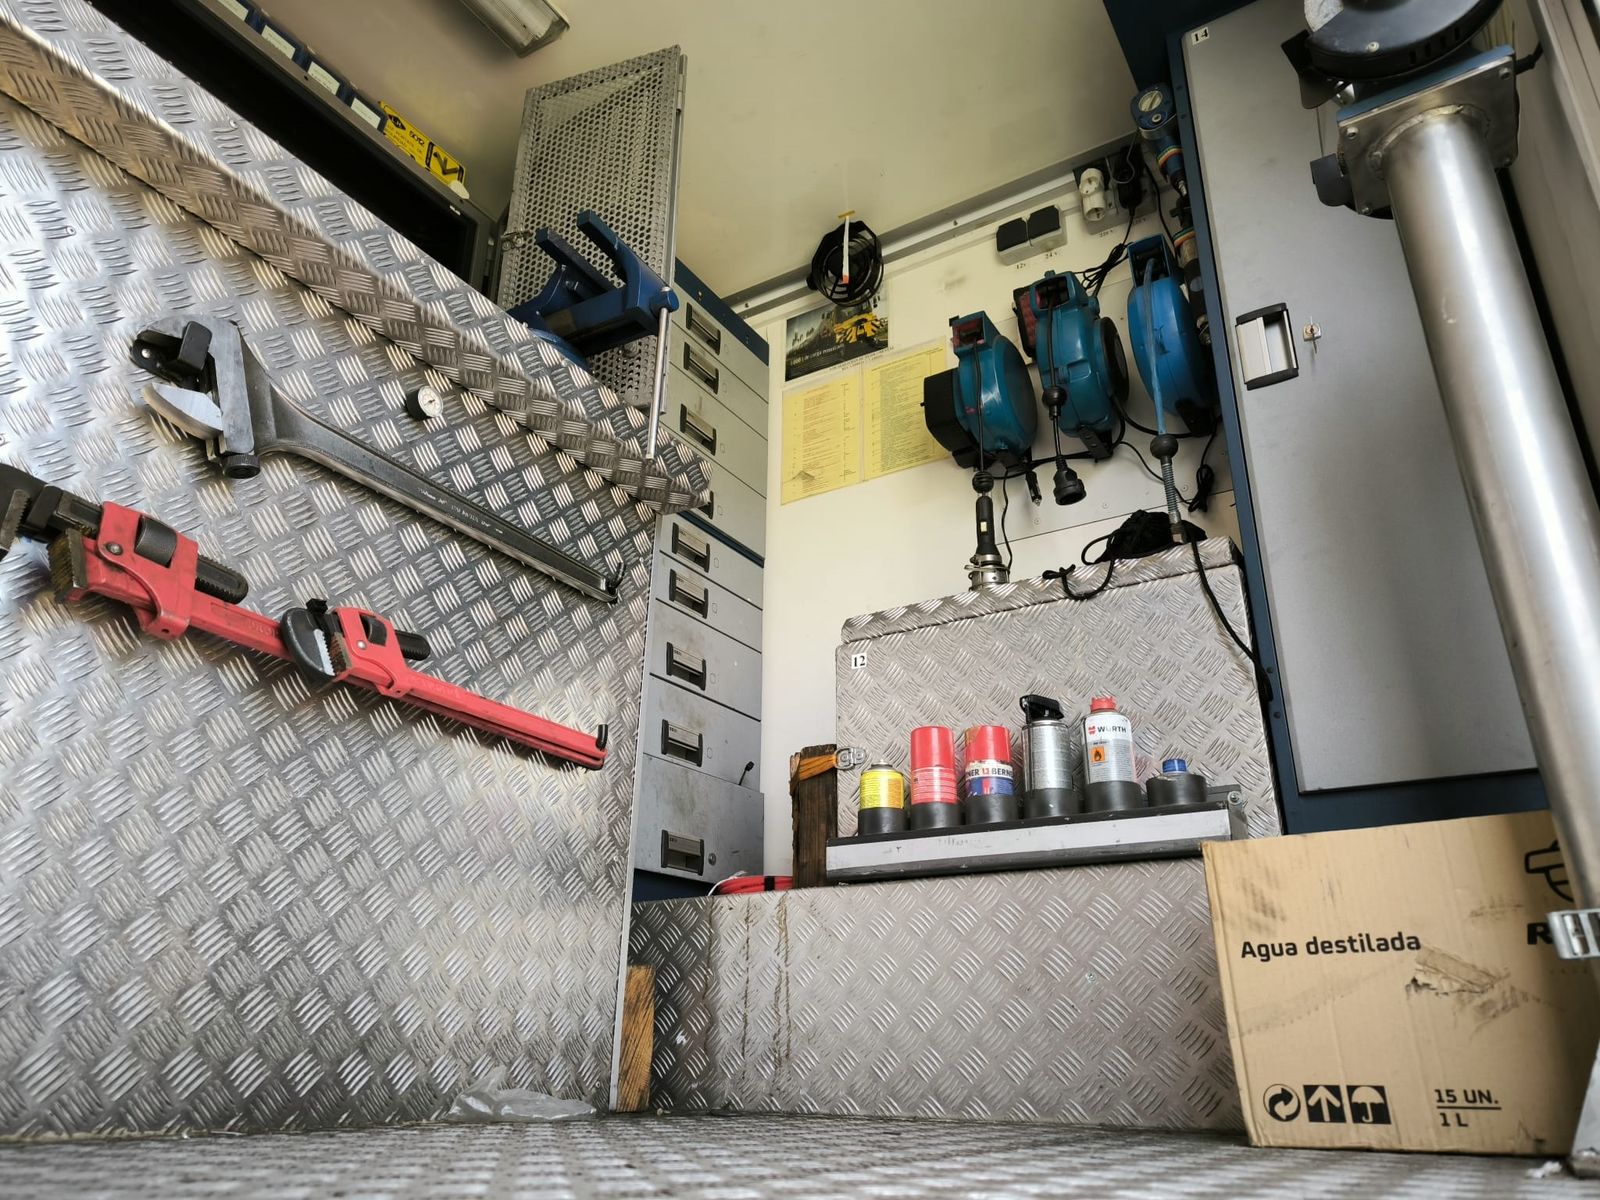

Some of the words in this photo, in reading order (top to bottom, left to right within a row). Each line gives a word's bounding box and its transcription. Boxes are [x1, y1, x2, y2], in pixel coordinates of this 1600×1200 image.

[1194, 28, 1209, 42] 14
[853, 655, 866, 668] 12
[1241, 940, 1298, 963] Agua
[1305, 931, 1422, 955] destilada
[1434, 1088, 1458, 1104] 15
[1462, 1088, 1499, 1104] UN.
[1439, 1112, 1451, 1127] 1
[1455, 1112, 1469, 1127] L
